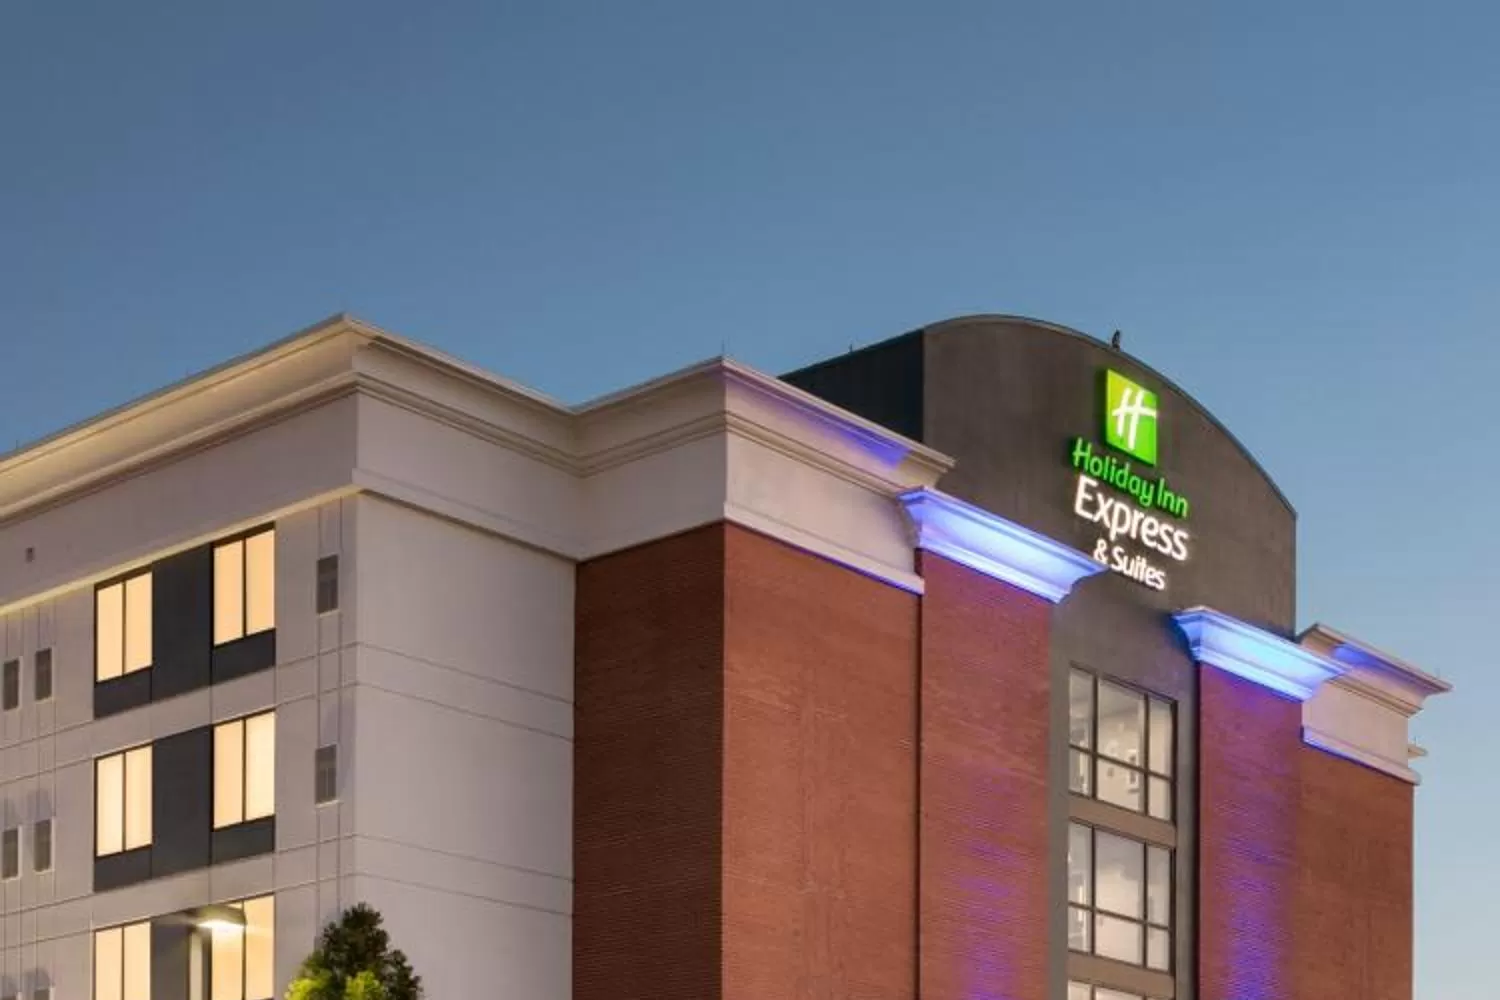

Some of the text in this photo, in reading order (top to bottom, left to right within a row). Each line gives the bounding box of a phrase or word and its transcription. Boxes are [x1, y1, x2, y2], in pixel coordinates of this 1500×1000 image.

[1073, 437, 1188, 518] Holiday Inn
[1074, 474, 1190, 562] Express
[1093, 538, 1166, 591] & Suites
